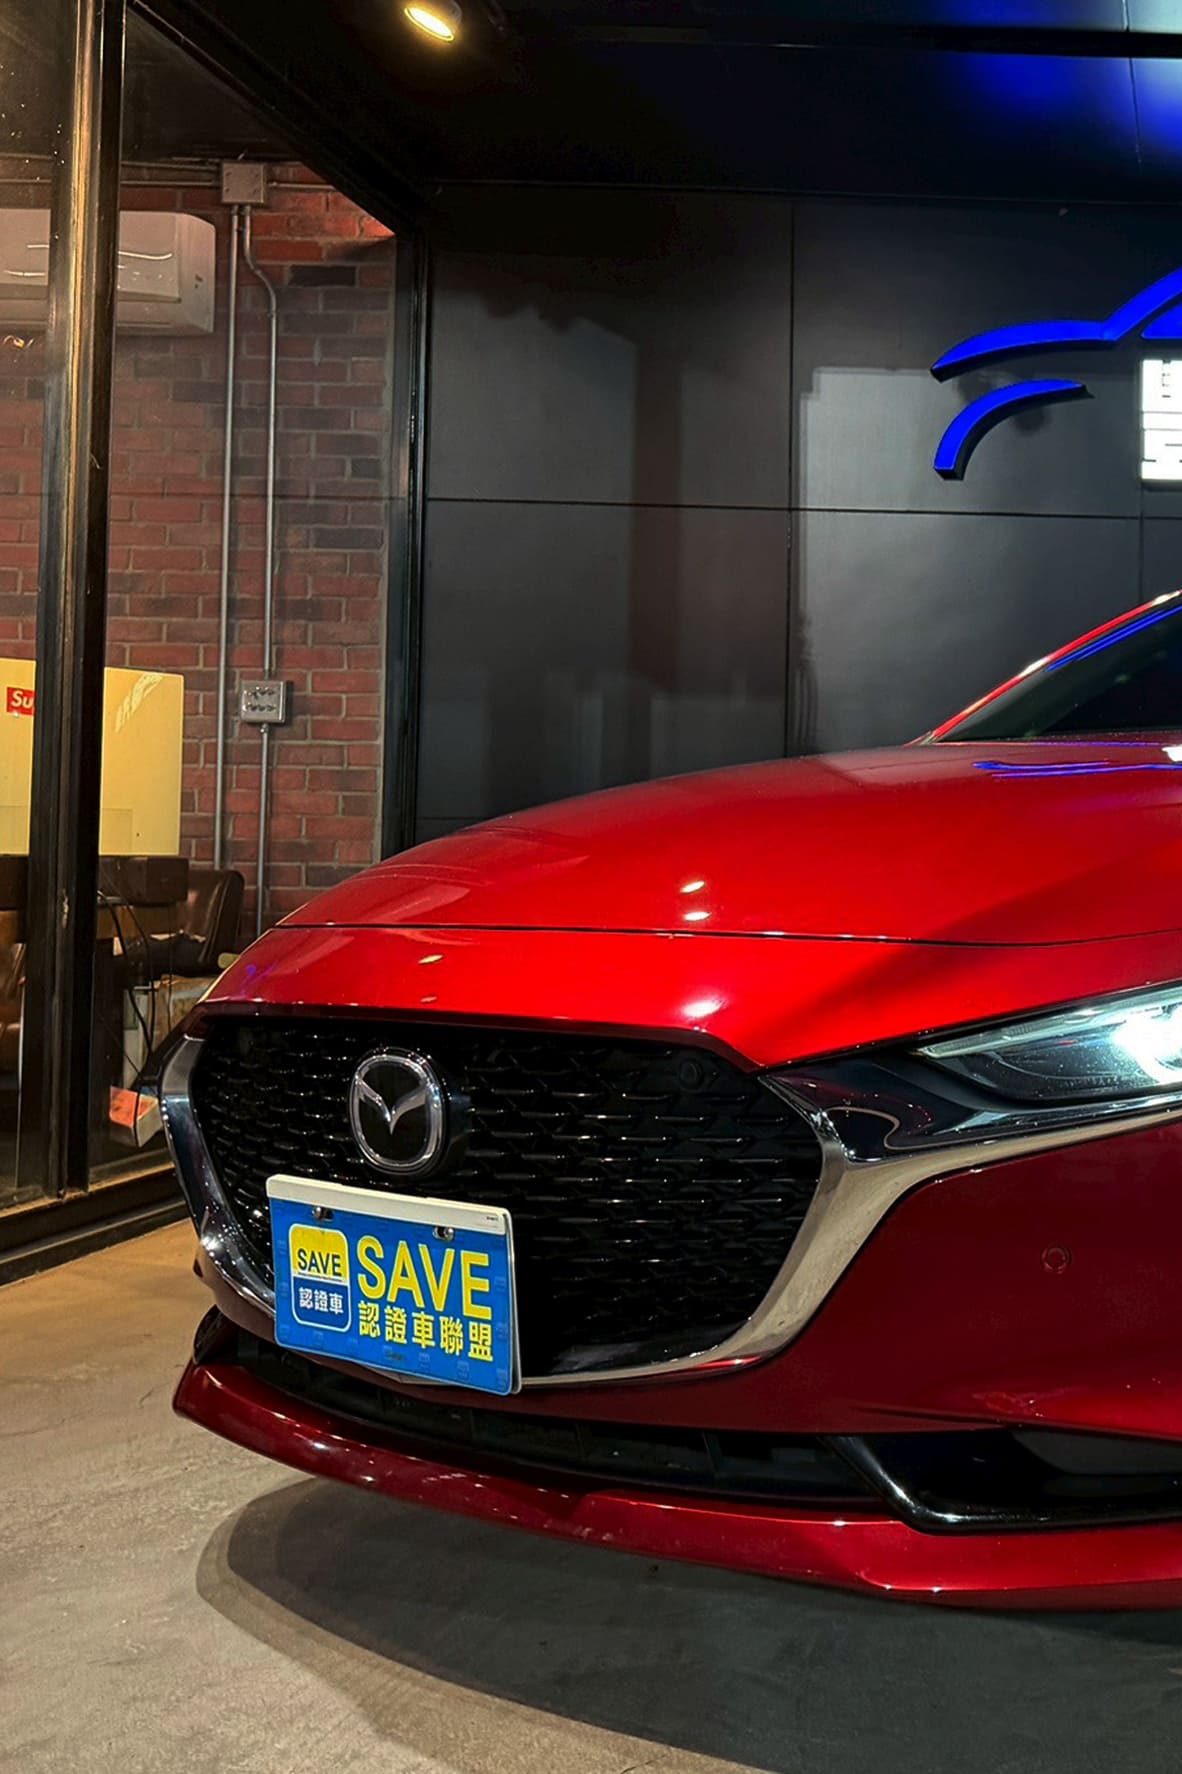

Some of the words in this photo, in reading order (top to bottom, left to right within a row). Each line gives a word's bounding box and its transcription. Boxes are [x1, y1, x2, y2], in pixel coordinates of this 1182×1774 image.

[297, 1248, 342, 1277] SAVE
[356, 1235, 493, 1321] SAVE
[298, 1286, 345, 1315] 認證車
[357, 1300, 493, 1362] 認證車聯盟
